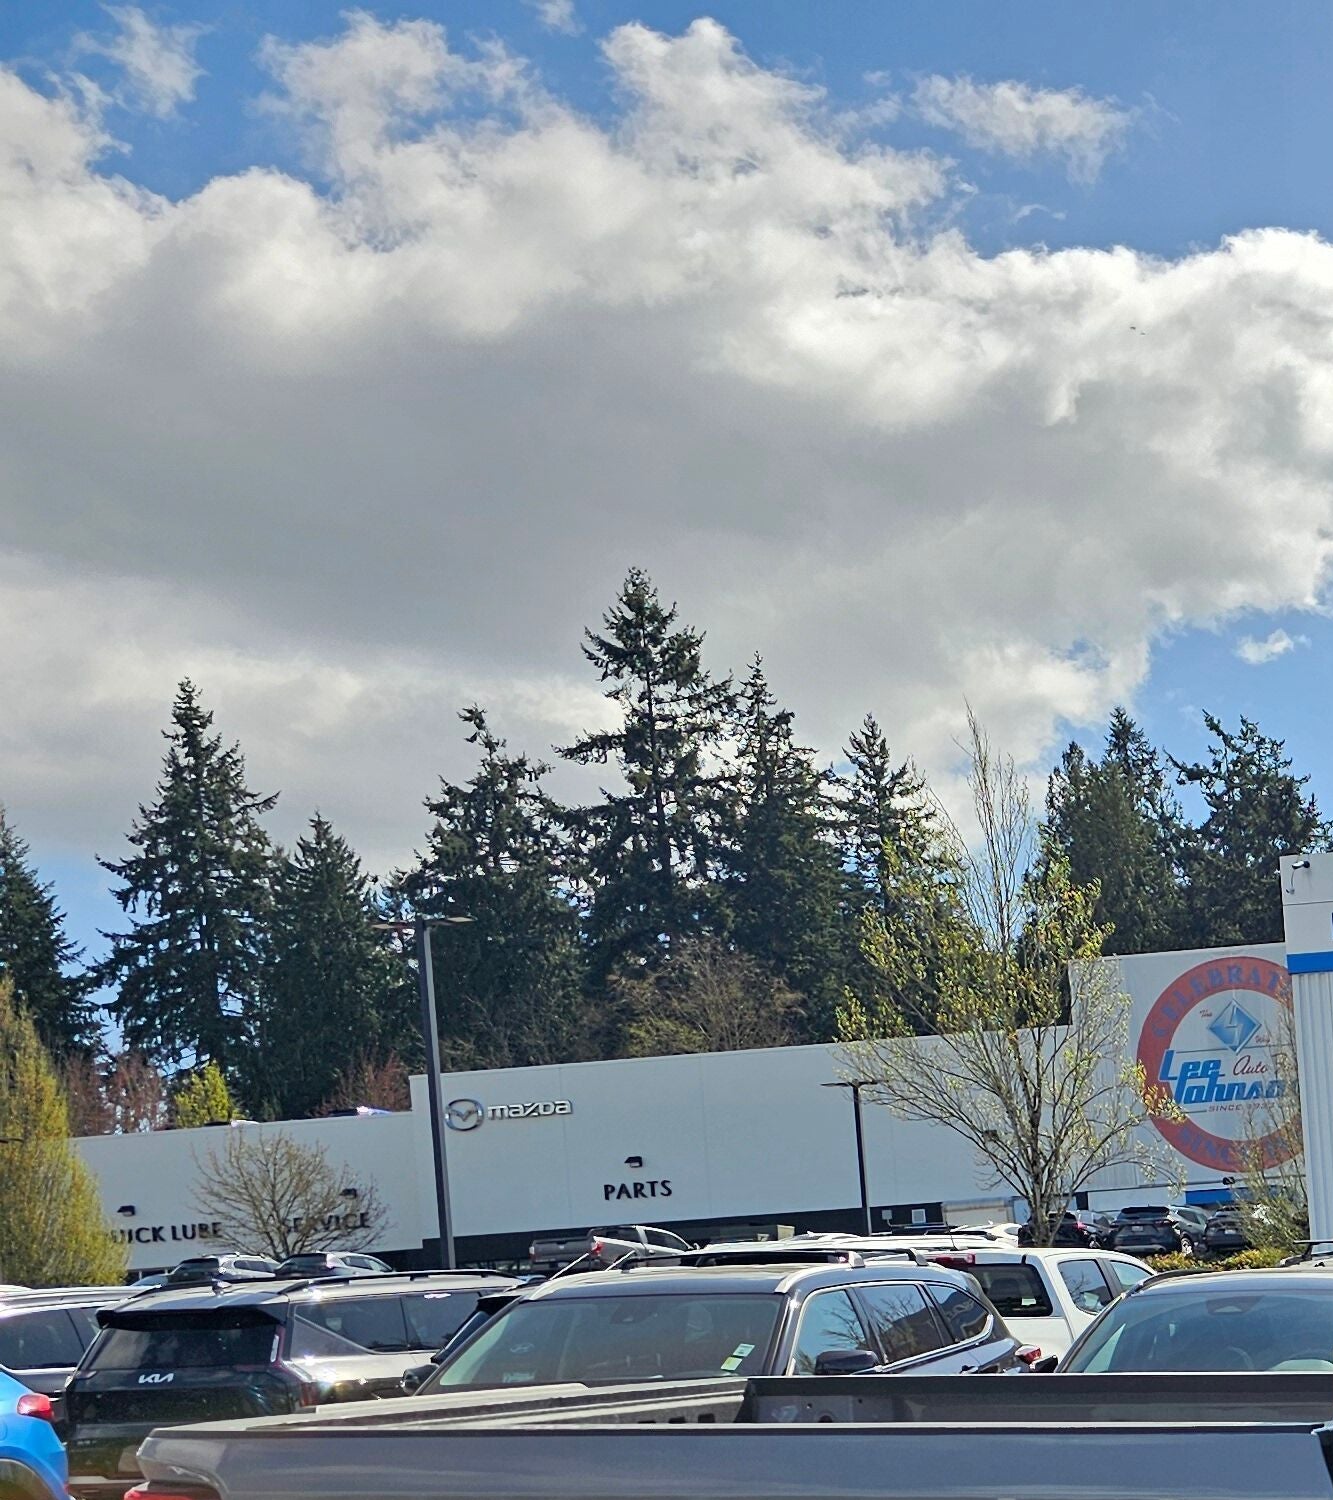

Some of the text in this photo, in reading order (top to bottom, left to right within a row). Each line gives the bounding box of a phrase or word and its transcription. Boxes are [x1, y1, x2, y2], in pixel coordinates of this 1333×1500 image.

[1152, 964, 1284, 1038] CELEBRAT
[1159, 1049, 1225, 1081] Lee
[1233, 1055, 1269, 1076] Auto
[1173, 1075, 1287, 1105] Johnso
[487, 1100, 573, 1121] mazda
[603, 1180, 673, 1201] PARTS
[107, 1222, 223, 1244] UICK LUBE
